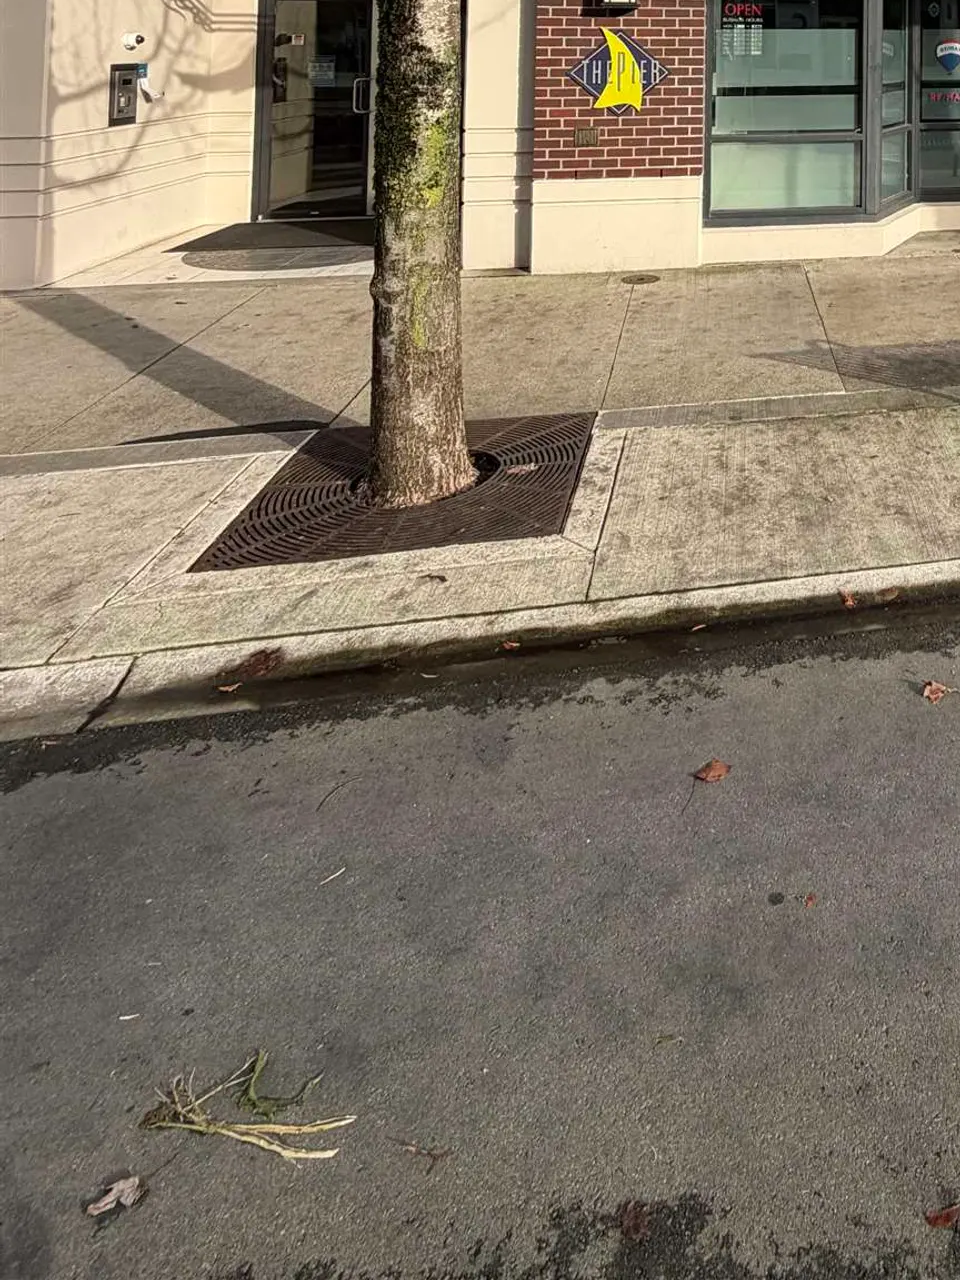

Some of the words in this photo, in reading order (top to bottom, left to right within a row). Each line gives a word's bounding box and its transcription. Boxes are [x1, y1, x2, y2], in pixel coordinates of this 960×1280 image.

[725, 4, 763, 16] OPEN
[582, 60, 613, 85] THE
[617, 51, 660, 92] PIER
